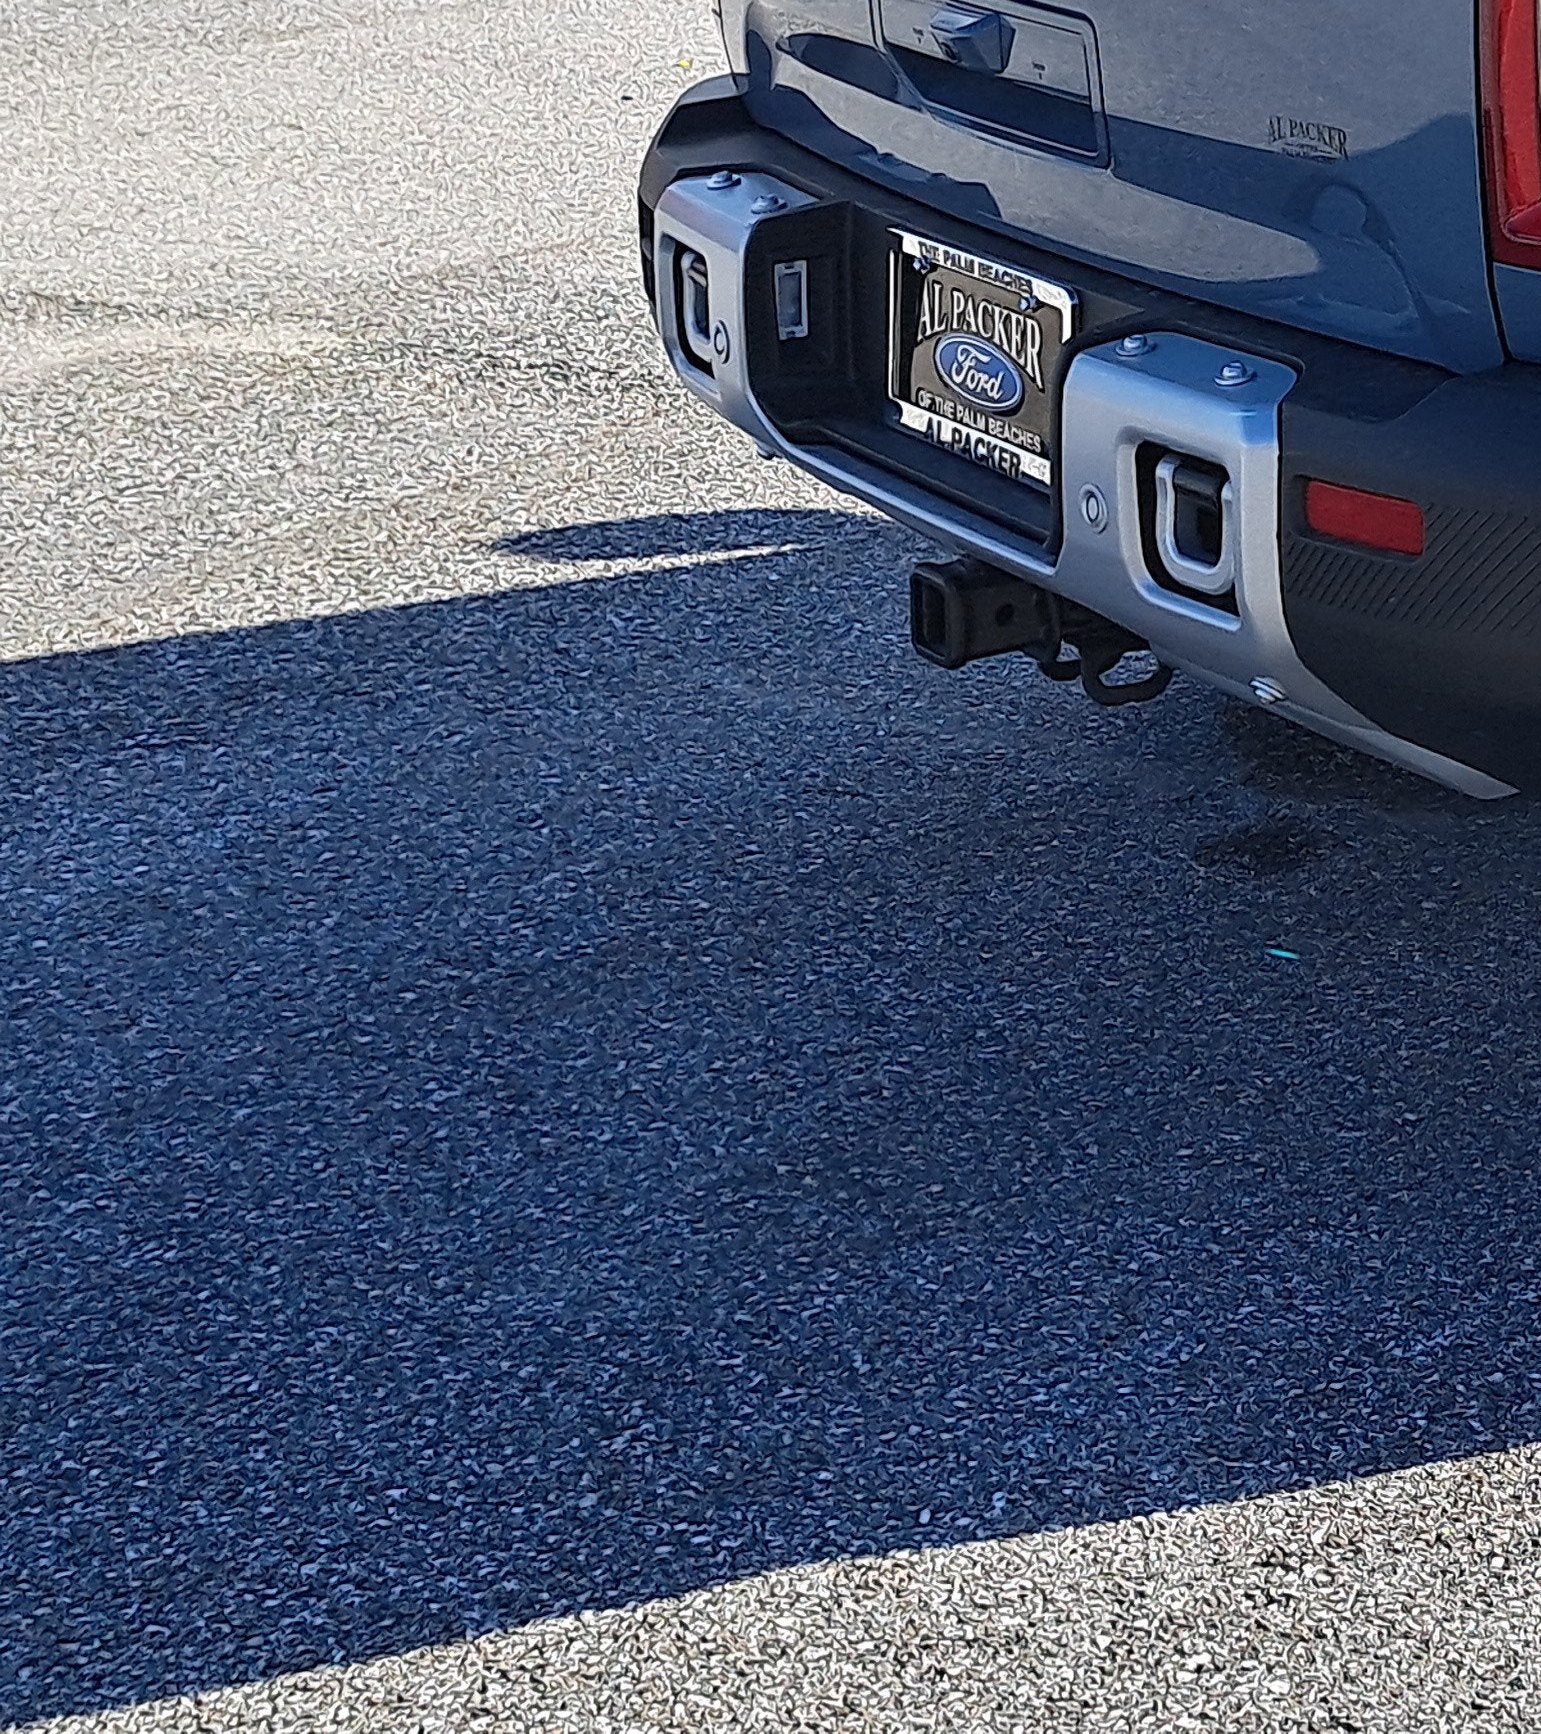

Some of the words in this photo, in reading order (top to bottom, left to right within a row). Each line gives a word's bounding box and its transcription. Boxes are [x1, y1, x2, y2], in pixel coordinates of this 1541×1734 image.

[1288, 117, 1350, 162] PACKER
[917, 281, 948, 342] AL
[952, 289, 1045, 391] PACKER
[951, 344, 1005, 402] Ford
[918, 391, 933, 409] OF
[933, 395, 956, 418] THE
[956, 404, 986, 428] PALM
[988, 416, 1043, 453] BEACHES
[950, 428, 1023, 479] PACKER
